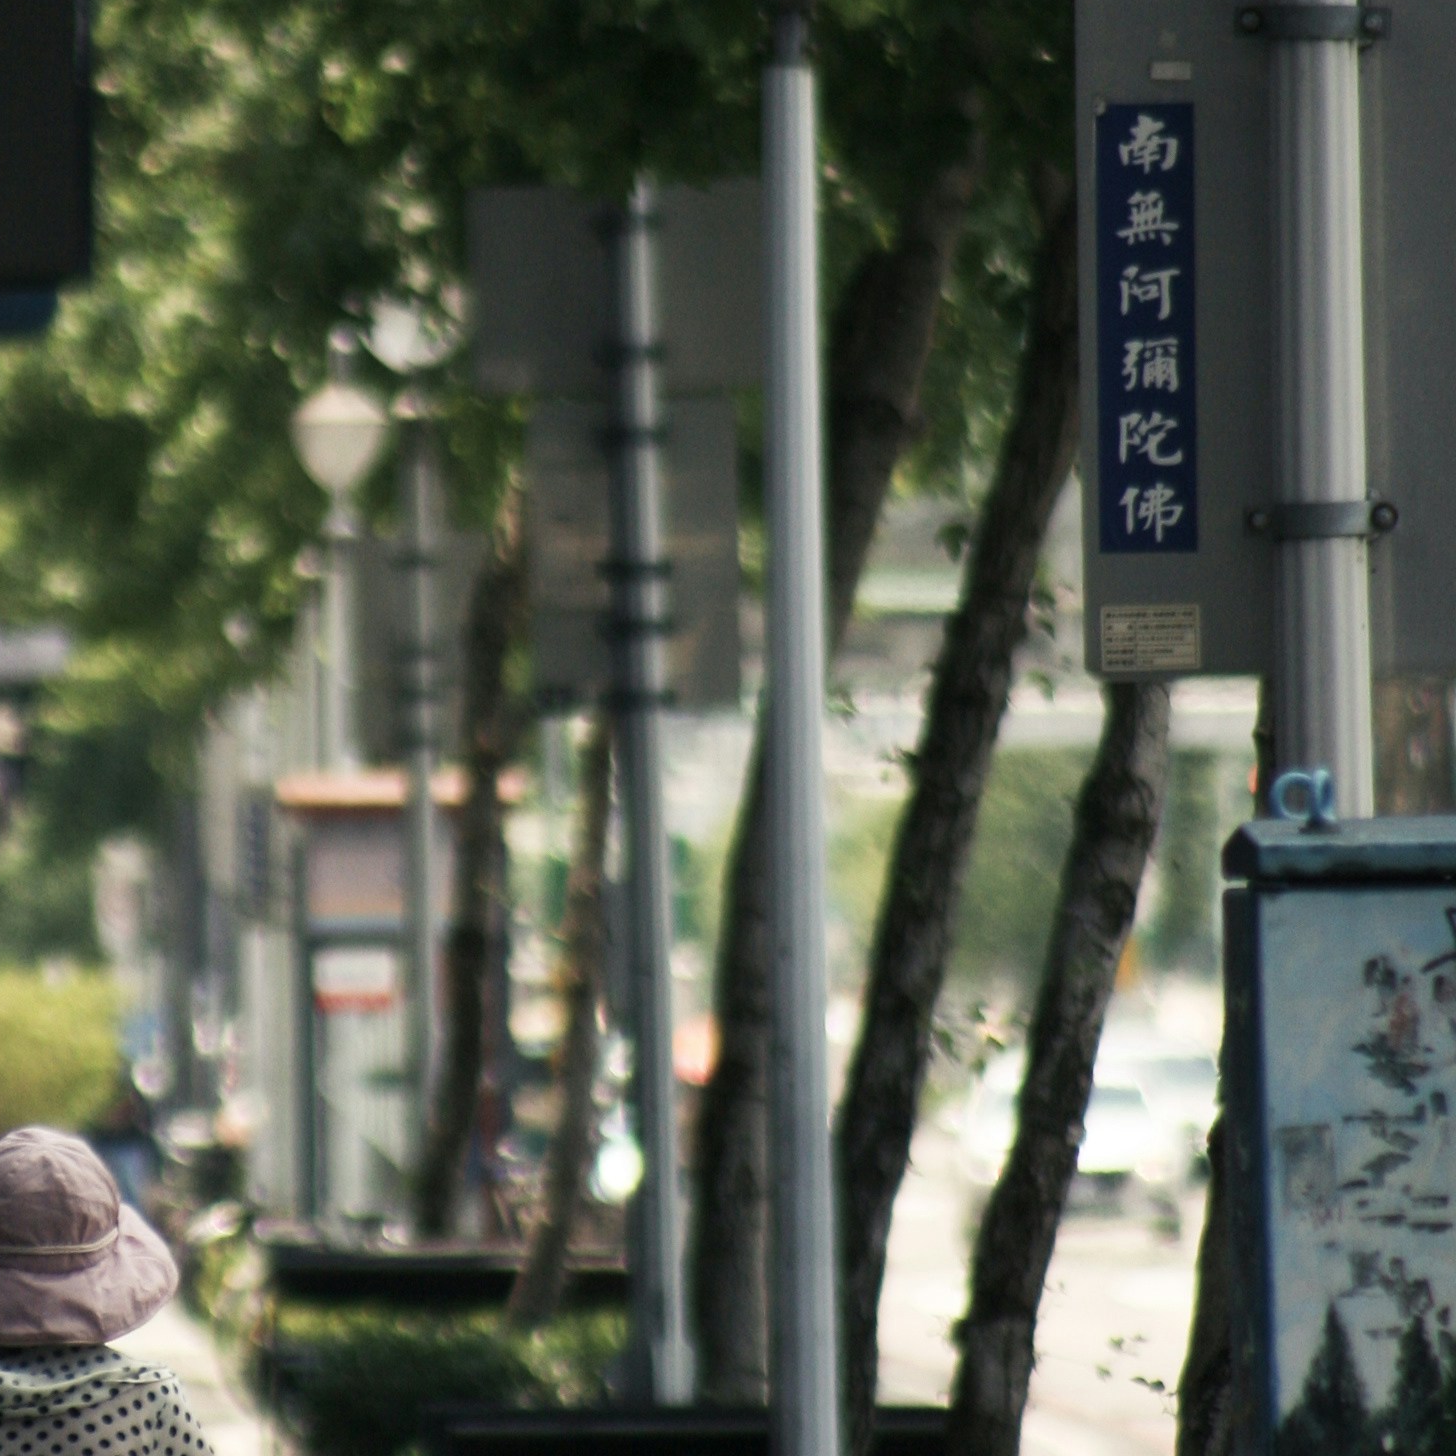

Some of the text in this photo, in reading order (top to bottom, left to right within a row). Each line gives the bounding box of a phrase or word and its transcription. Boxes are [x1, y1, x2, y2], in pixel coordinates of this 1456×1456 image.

[1115, 115, 1184, 543] 南無阿彌陀佛
